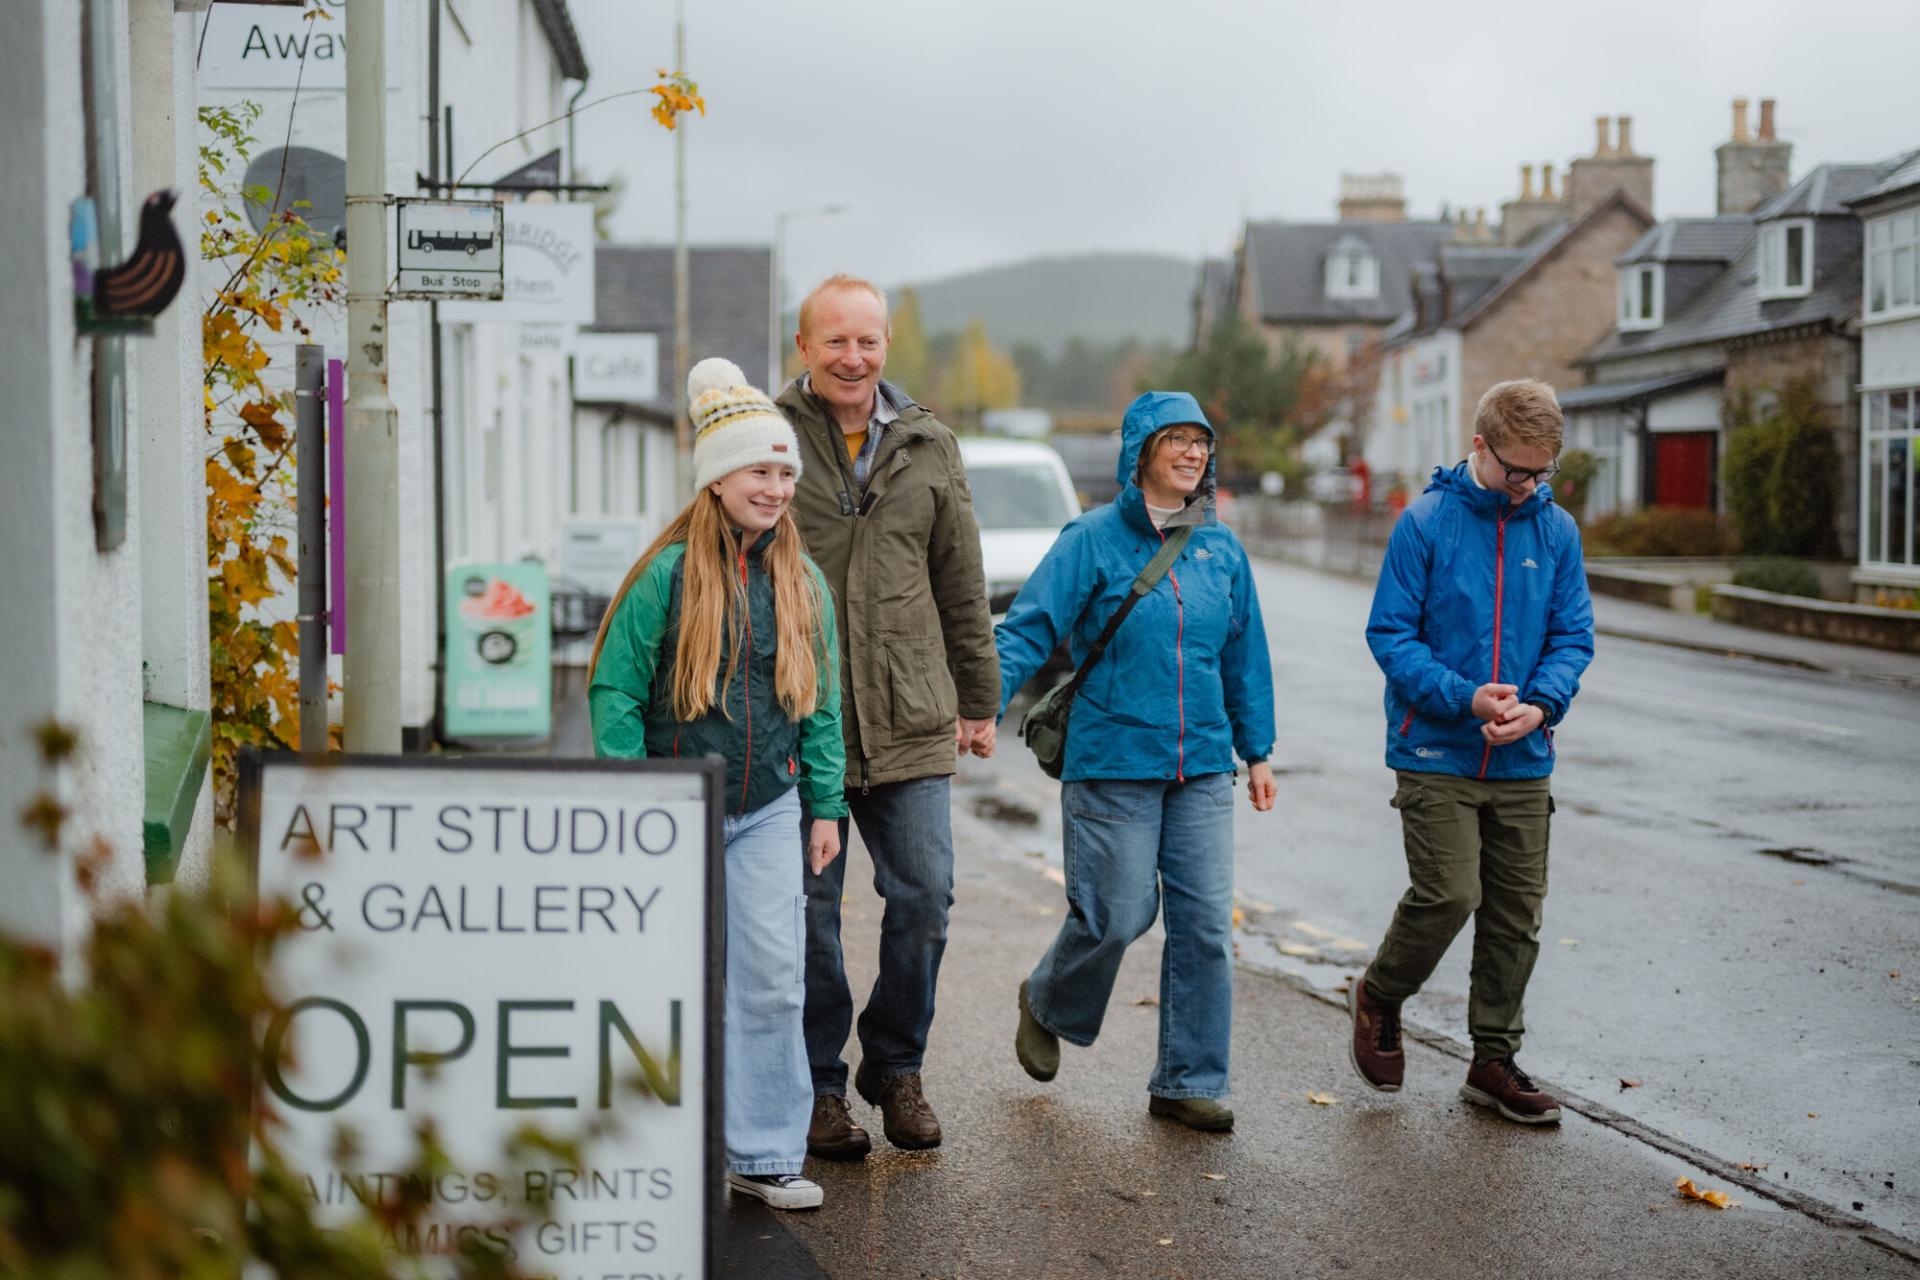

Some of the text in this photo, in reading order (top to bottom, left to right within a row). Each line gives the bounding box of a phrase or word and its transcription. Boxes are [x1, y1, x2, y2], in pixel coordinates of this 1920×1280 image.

[421, 275, 481, 289] Bus Stop
[279, 803, 679, 856] ART STUDIO
[298, 882, 661, 934] & GALLERY
[262, 996, 683, 1113] OPEN
[523, 1168, 674, 1203] PRINTS
[536, 1220, 659, 1256] GIFTS
